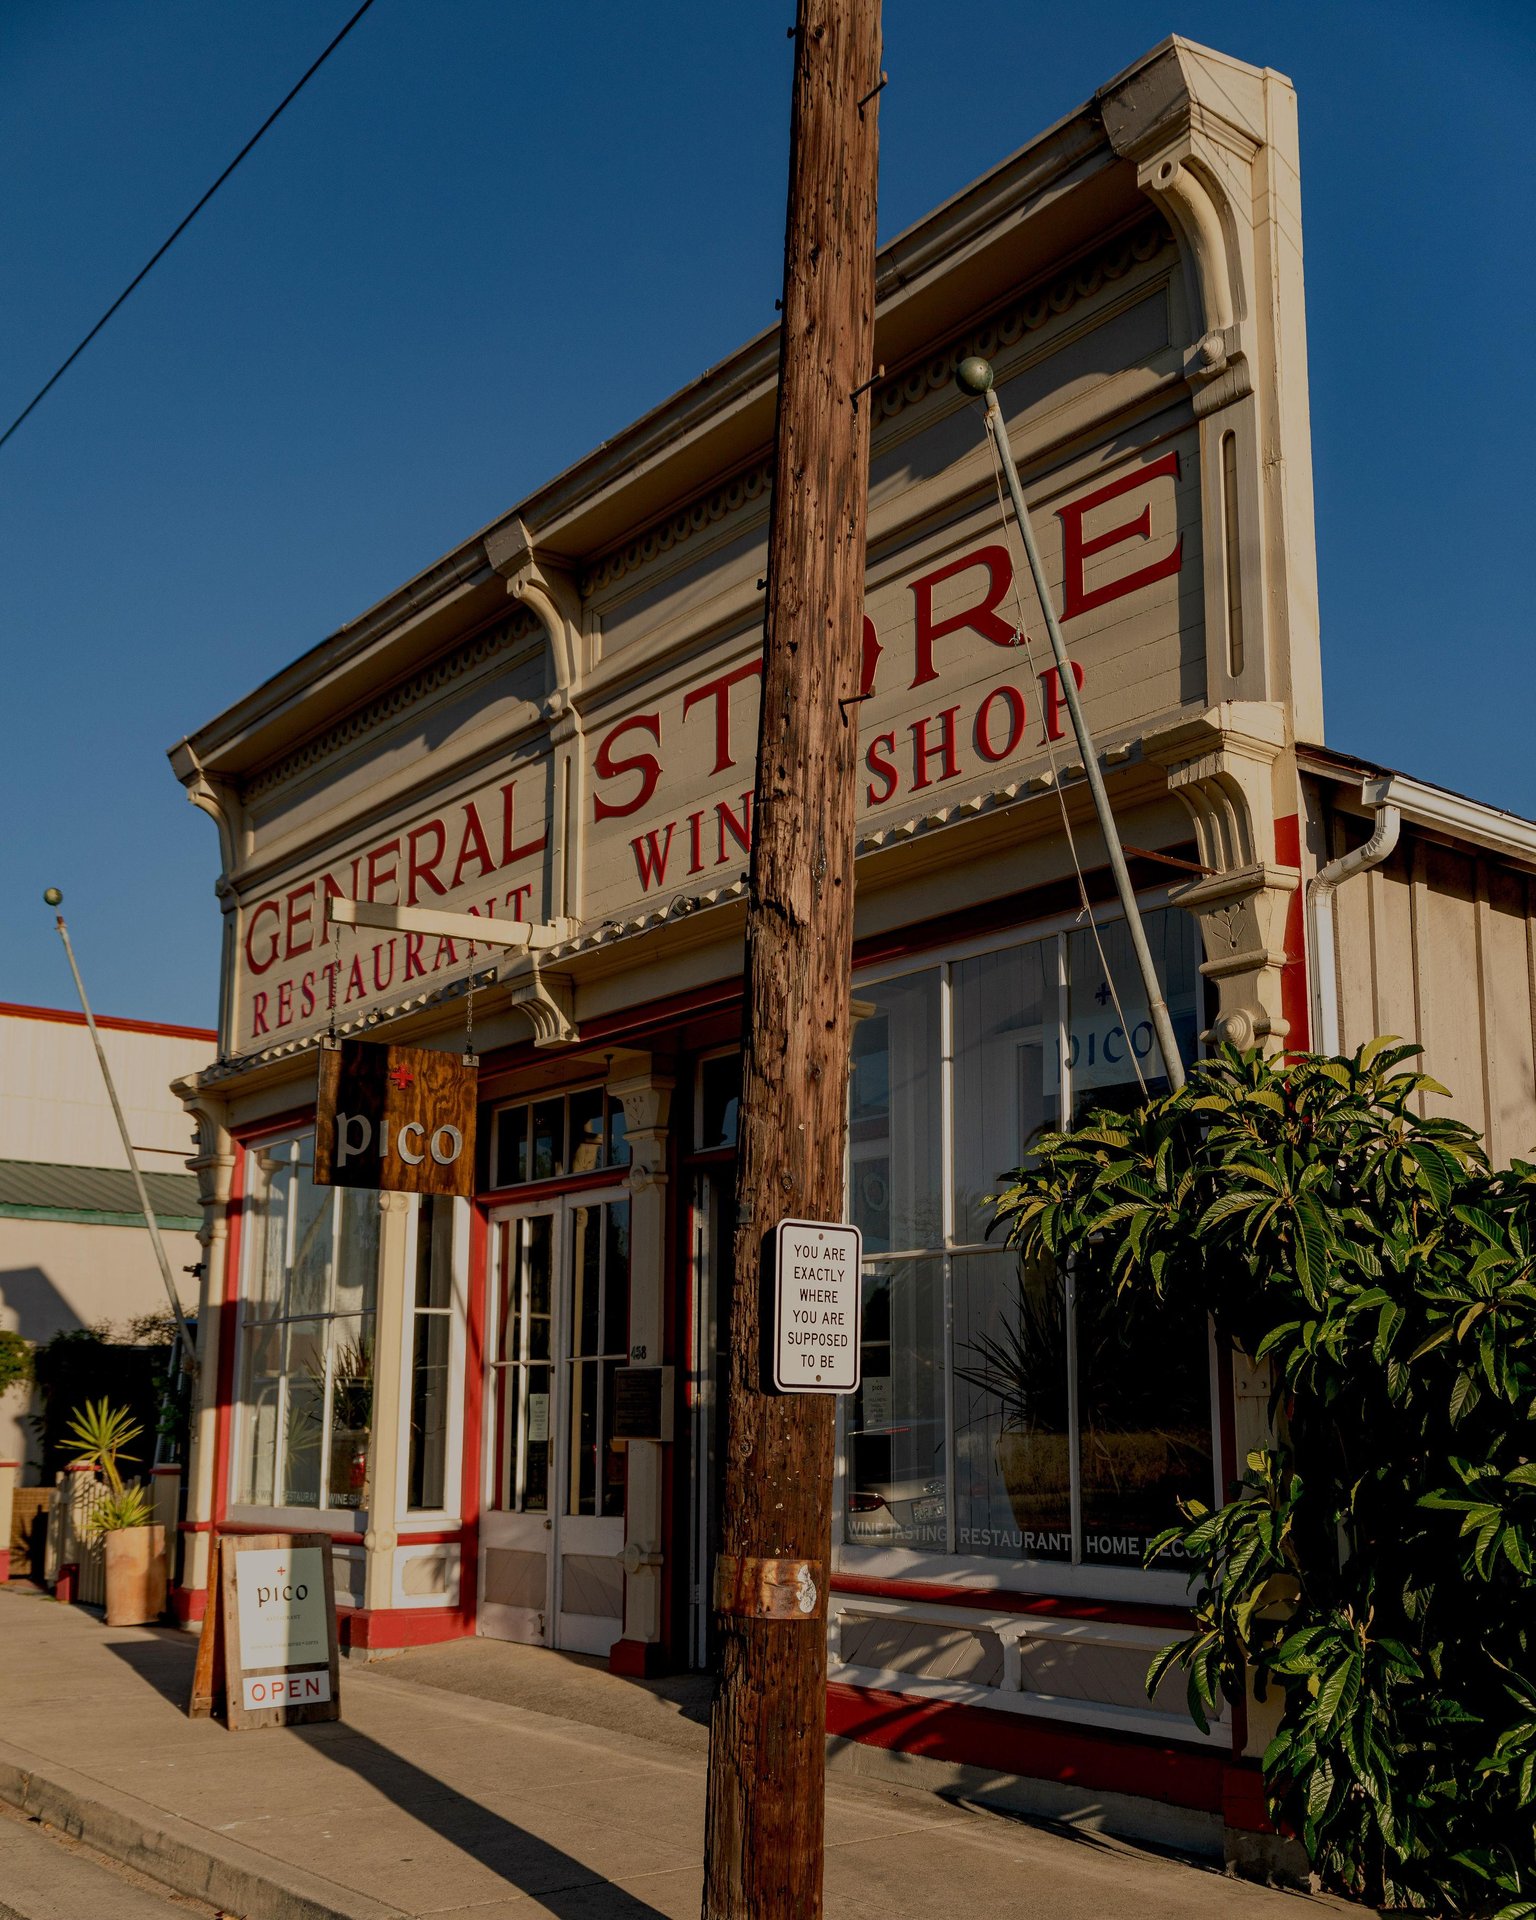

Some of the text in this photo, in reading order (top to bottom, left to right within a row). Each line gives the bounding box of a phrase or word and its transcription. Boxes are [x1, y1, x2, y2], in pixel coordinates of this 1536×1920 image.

[245, 450, 1183, 975] GENERAL STRE
[629, 660, 1084, 892] WIN SHOP
[336, 1112, 463, 1168] pico
[794, 1244, 846, 1261] YOU ARE
[794, 1266, 845, 1282] EXACTLY
[800, 1288, 838, 1304] WHERE
[793, 1310, 845, 1325] YOU ARE
[788, 1331, 848, 1347] SUPPOSED
[801, 1354, 835, 1368] TO BE
[848, 1521, 948, 1542] WINE TASTING
[960, 1528, 1072, 1551] RESTAURANT
[1086, 1535, 1140, 1556] HOME
[257, 1584, 309, 1608] pico
[251, 1677, 320, 1702] OPEN
